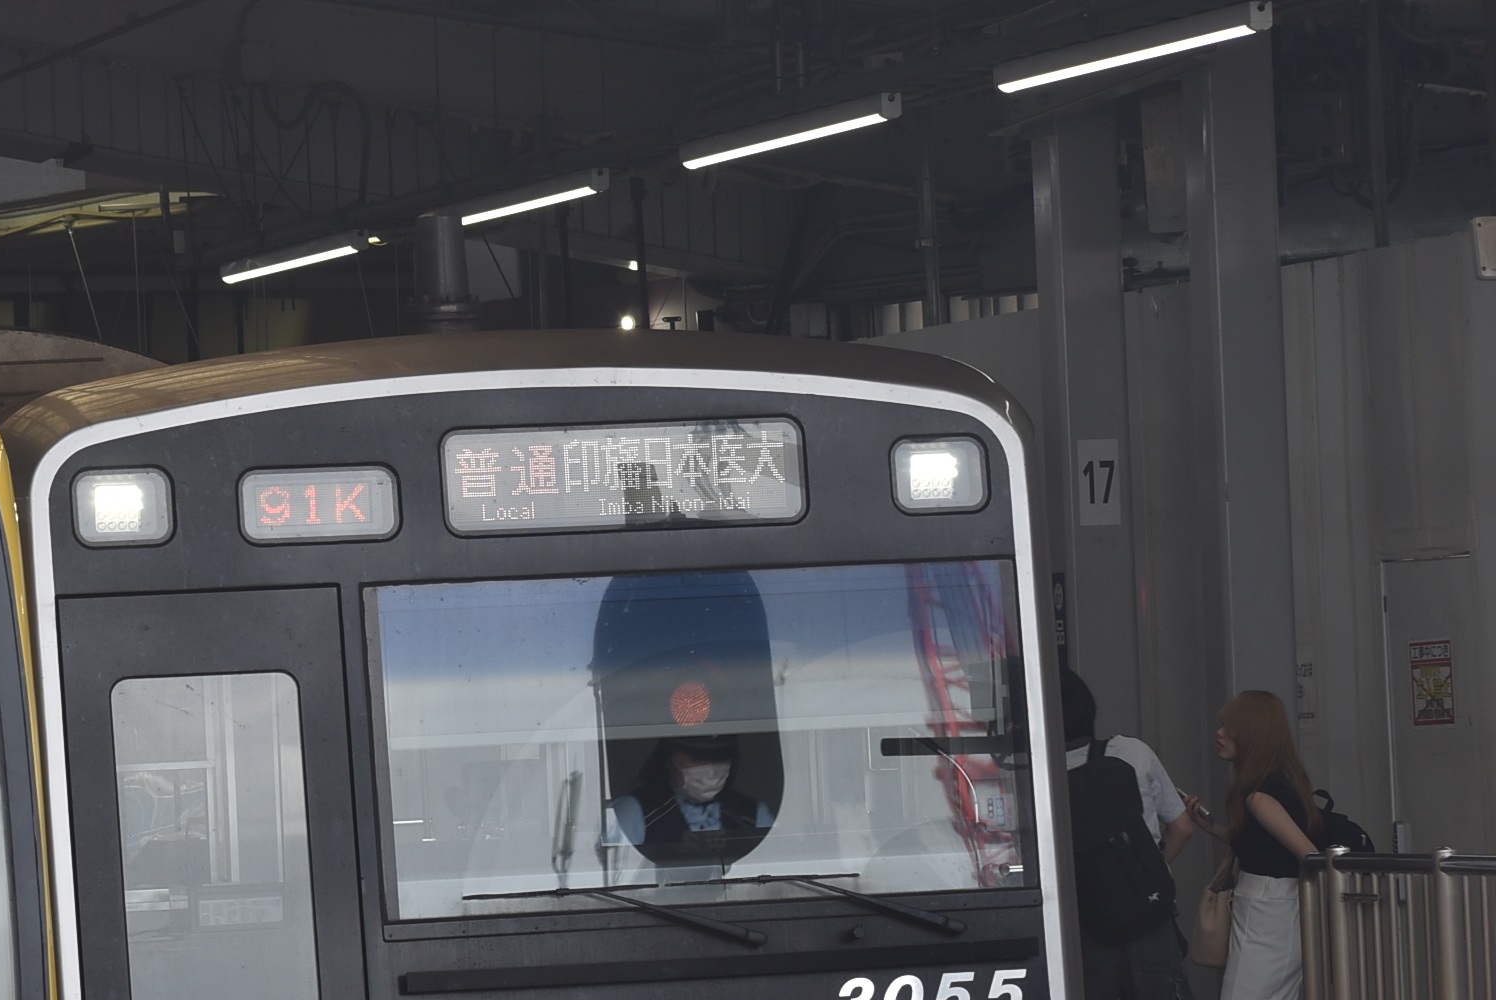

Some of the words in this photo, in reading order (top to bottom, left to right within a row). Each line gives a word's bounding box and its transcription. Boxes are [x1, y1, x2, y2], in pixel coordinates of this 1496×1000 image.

[455, 445, 559, 498] 普通
[563, 430, 786, 493] 印旛日本医大
[1082, 460, 1115, 505] 17
[260, 483, 367, 527] 91K
[481, 501, 536, 522] Local
[598, 497, 644, 517] Imba
